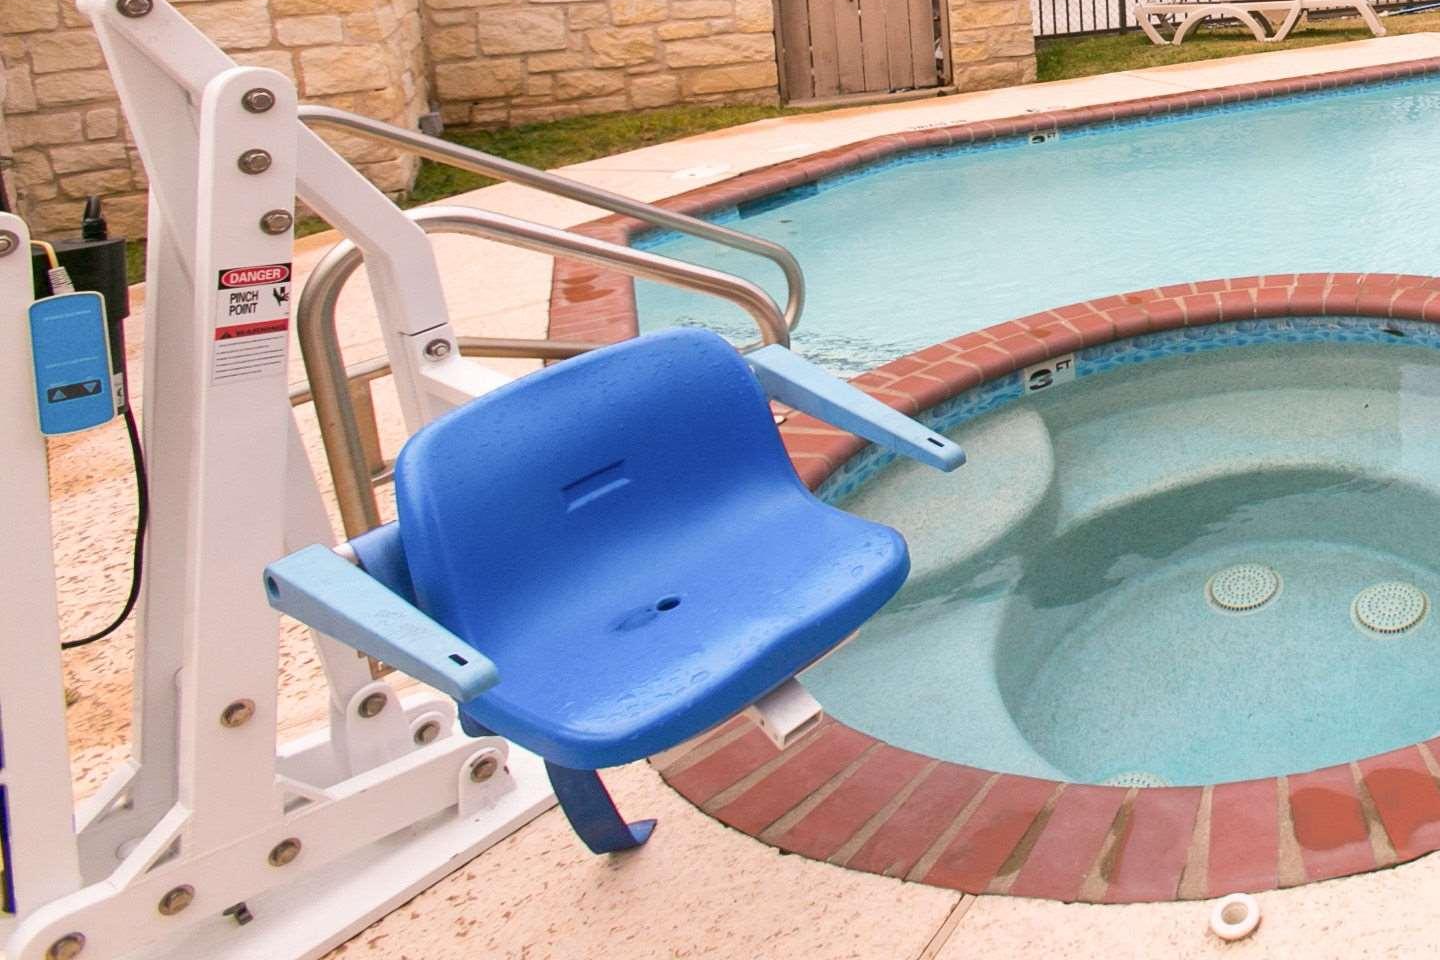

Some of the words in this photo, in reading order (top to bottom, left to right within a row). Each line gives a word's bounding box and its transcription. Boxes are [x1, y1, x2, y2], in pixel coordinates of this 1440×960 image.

[230, 268, 281, 284] DANGER
[230, 290, 259, 304] PINCH
[229, 302, 258, 316] POINT
[1028, 368, 1054, 391] 3
[1055, 359, 1073, 373] FT
